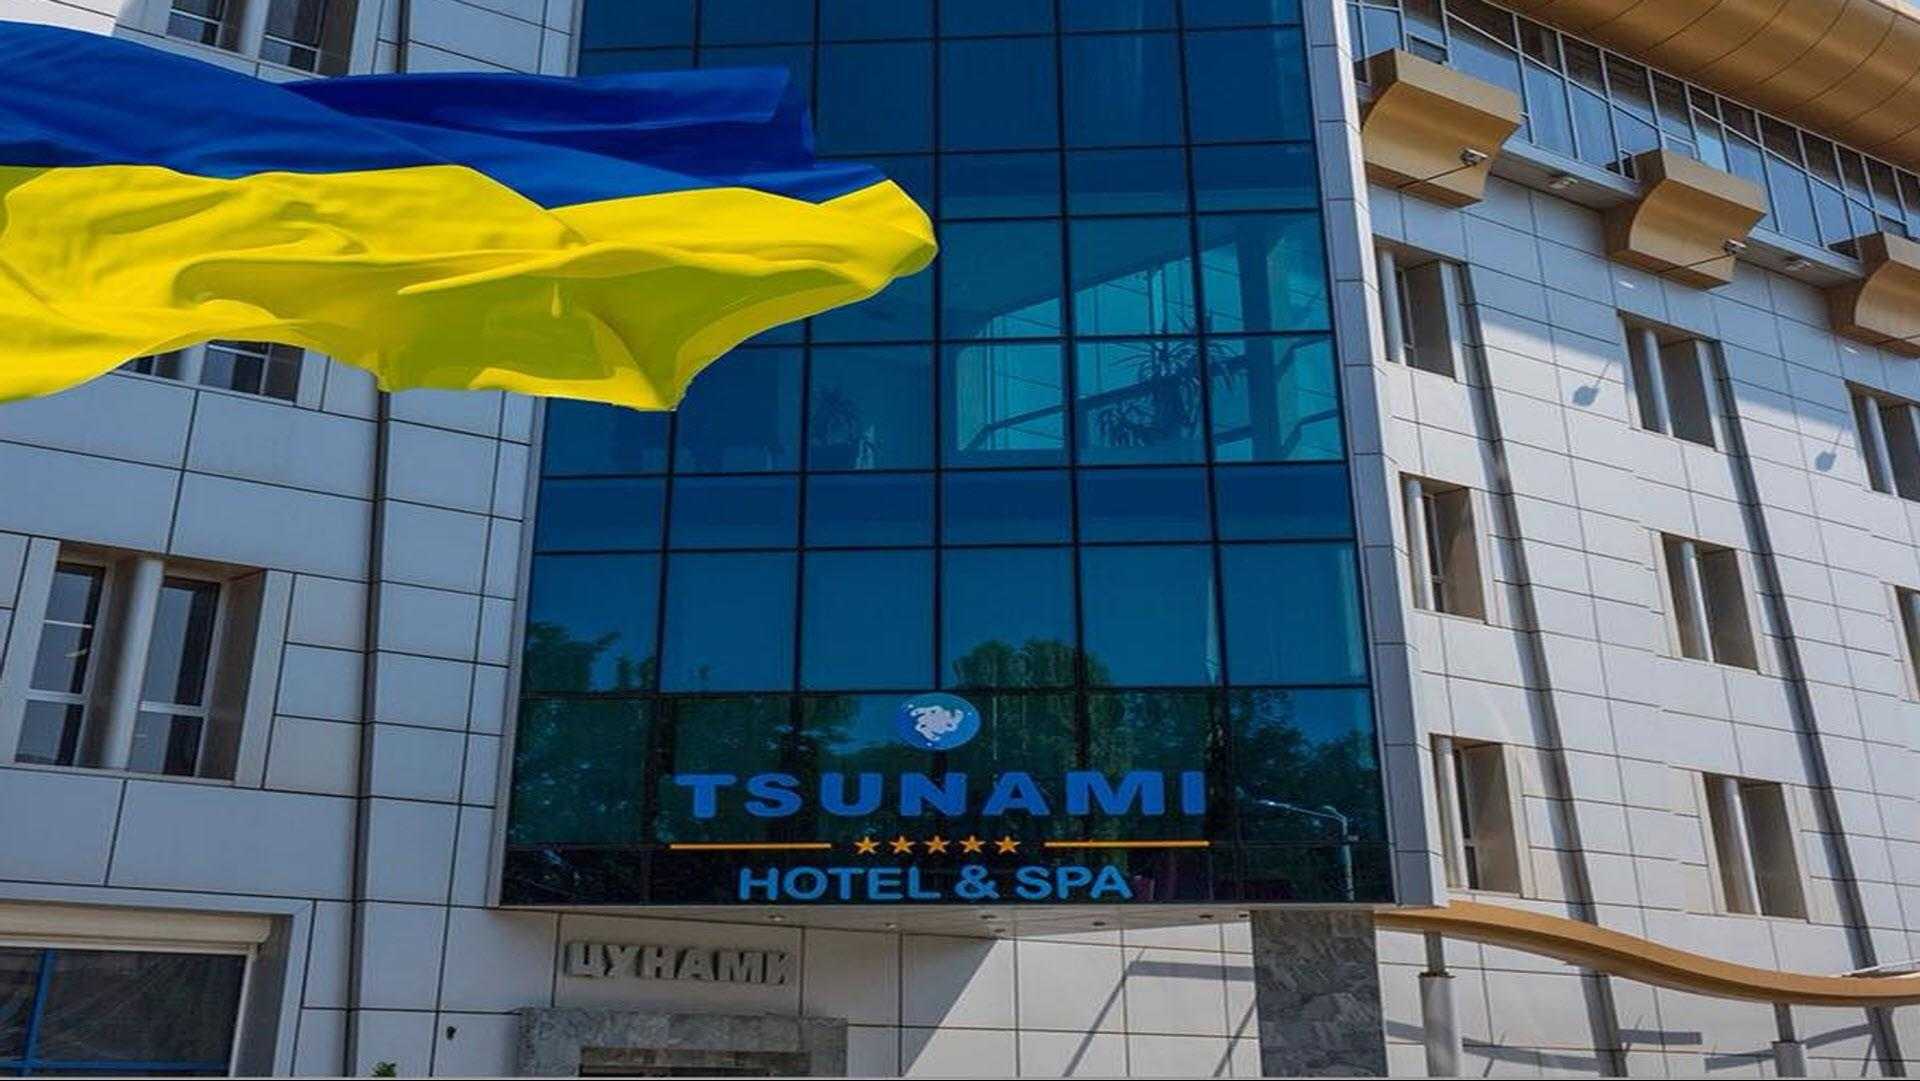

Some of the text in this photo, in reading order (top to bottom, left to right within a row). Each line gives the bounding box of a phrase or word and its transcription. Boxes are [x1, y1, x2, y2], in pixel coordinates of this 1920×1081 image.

[674, 770, 1207, 818] TSUNAMI
[738, 864, 1133, 901] HOTEL & SPA
[564, 940, 790, 985] ЦУНАМИ
